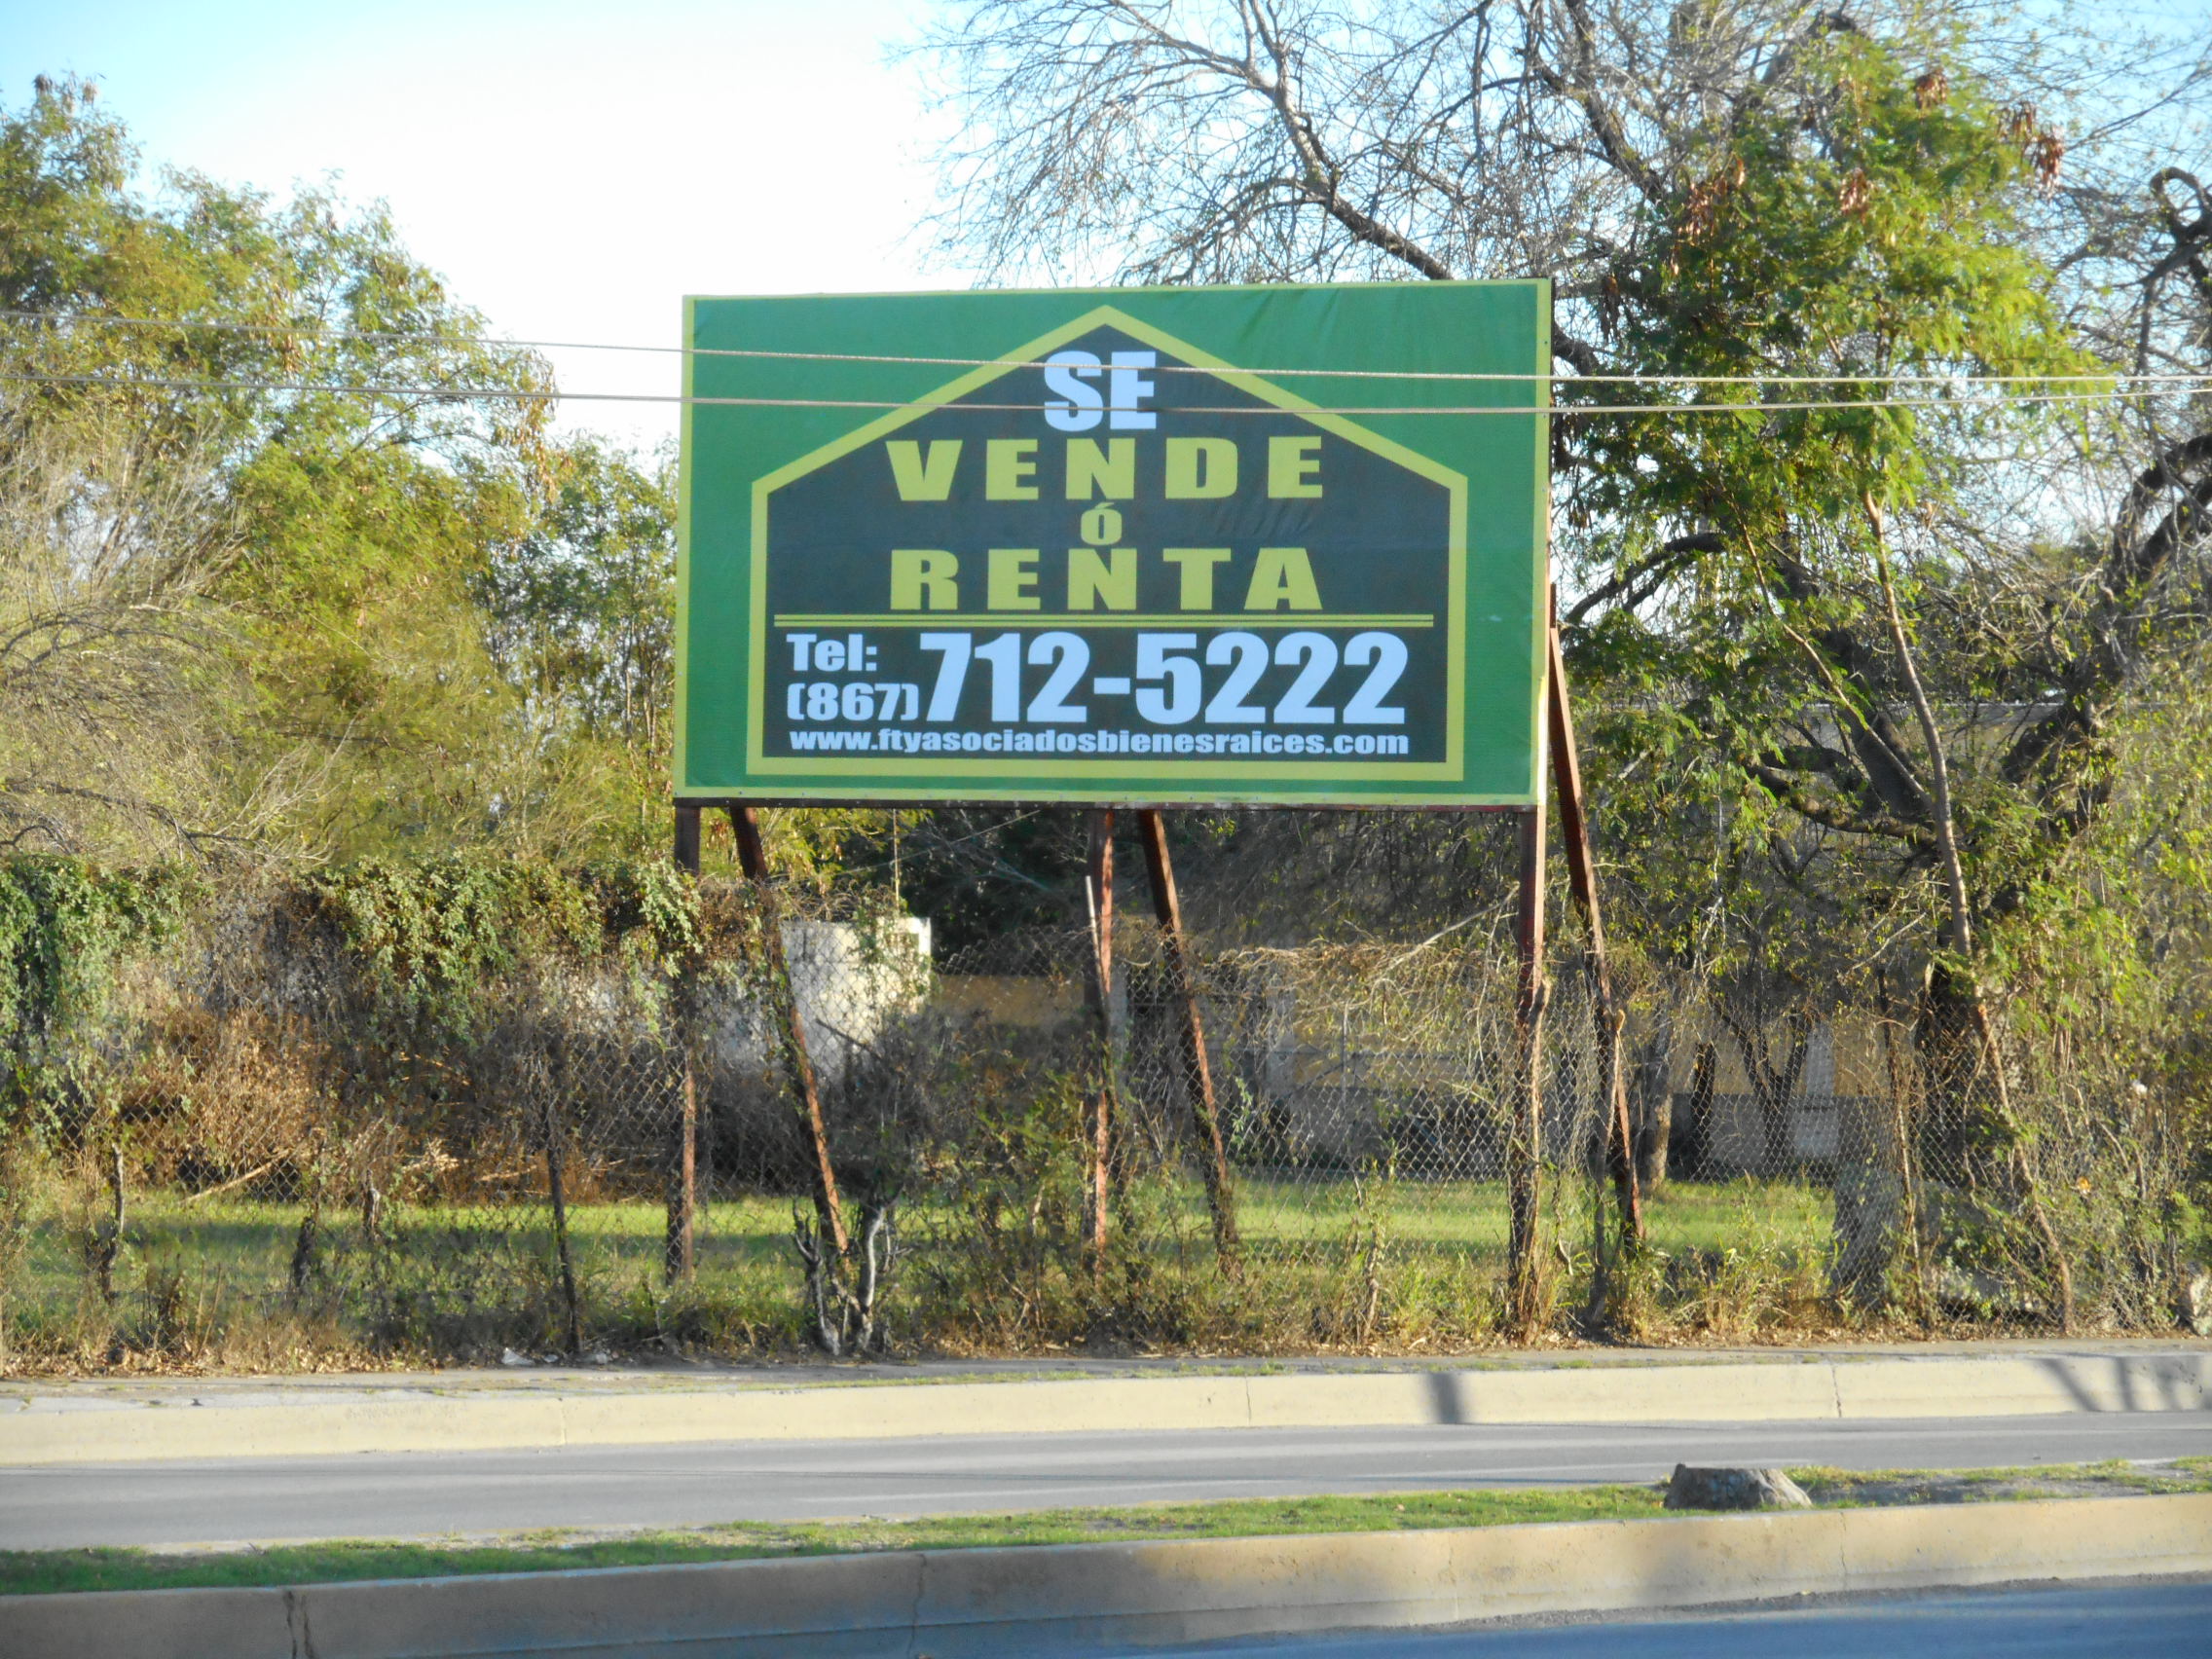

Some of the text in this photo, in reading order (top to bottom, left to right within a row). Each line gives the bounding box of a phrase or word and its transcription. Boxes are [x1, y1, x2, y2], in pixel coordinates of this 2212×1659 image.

[1043, 350, 1158, 433] SE
[885, 435, 1324, 501] VENDE
[1080, 502, 1122, 546] Ó
[890, 546, 1322, 611] RENTA
[786, 632, 877, 672] Tel:
[918, 632, 1410, 725] 712-5222
[787, 682, 919, 722] (867)
[789, 726, 1410, 756] www.ftyasociadosbienesraices.com
